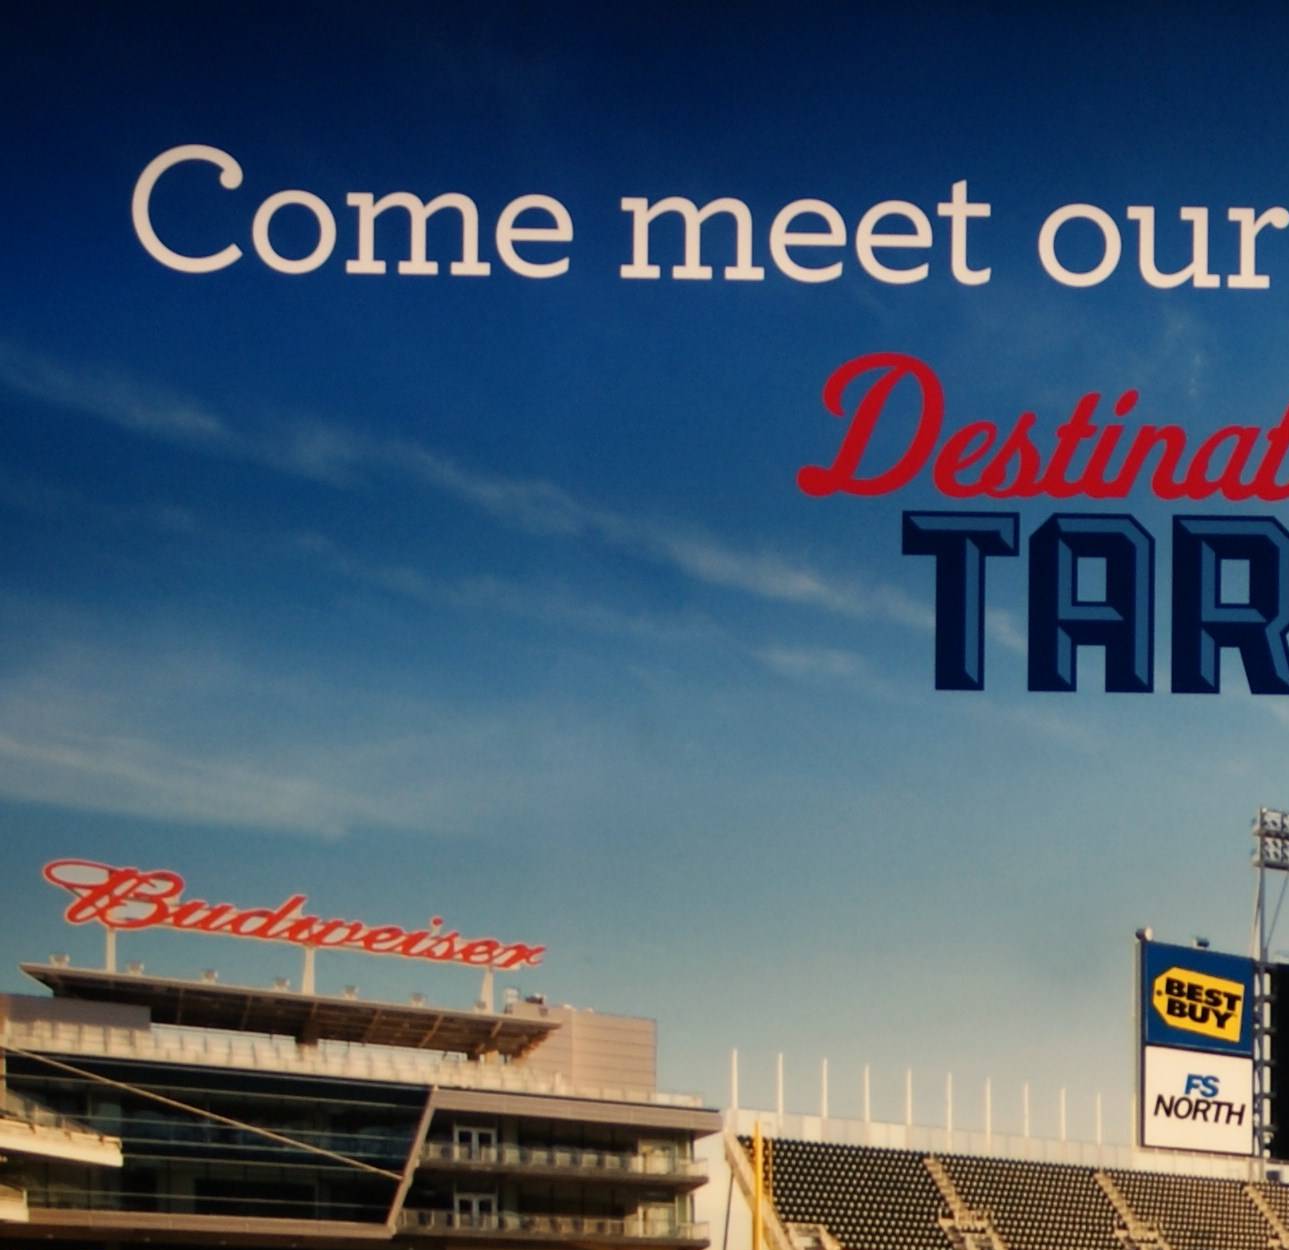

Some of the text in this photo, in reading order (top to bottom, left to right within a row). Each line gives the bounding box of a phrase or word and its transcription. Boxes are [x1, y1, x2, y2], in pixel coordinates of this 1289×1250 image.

[132, 144, 574, 280] Come
[619, 179, 993, 286] meet
[42, 857, 547, 971] Budweiser
[1165, 976, 1242, 1012] BEST
[1166, 997, 1233, 1030] BUY
[1184, 1073, 1220, 1098] FS
[1153, 1093, 1246, 1127] NORTH
